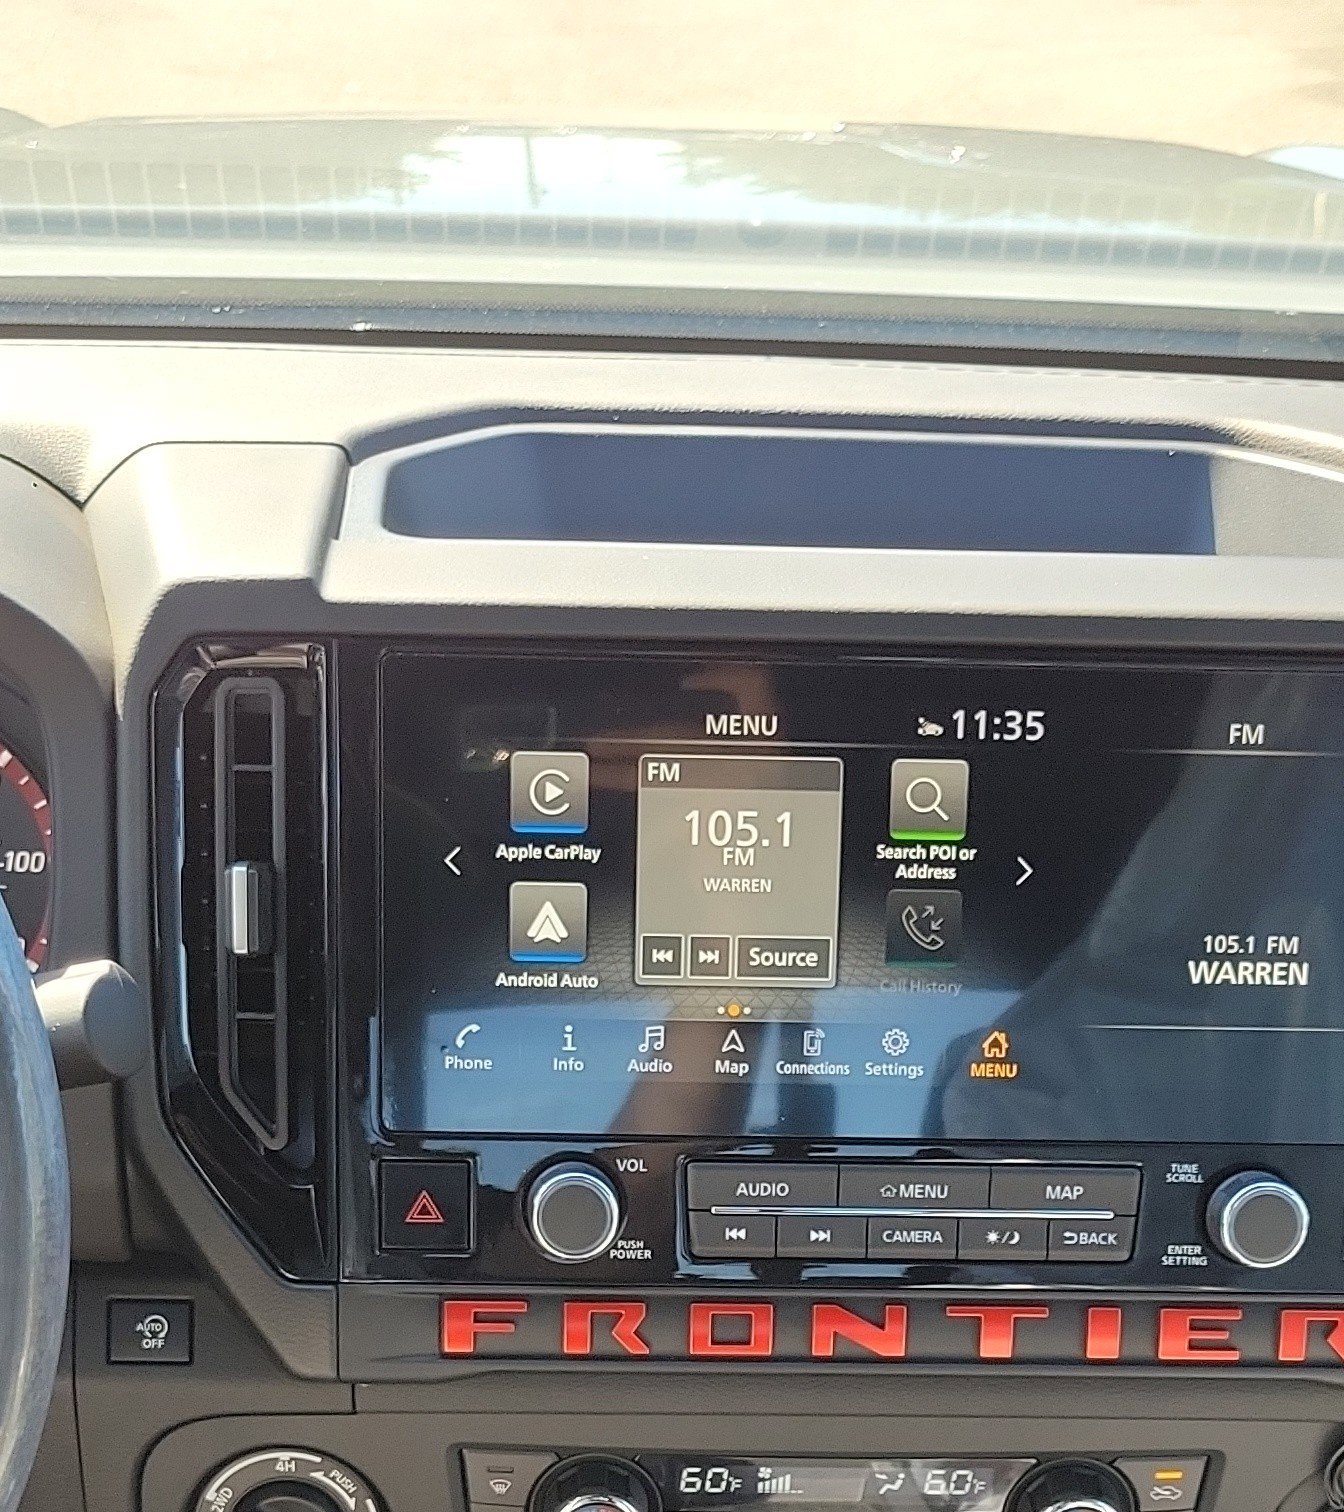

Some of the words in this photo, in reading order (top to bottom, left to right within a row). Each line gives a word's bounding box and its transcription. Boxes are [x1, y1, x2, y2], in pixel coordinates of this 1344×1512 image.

[706, 714, 777, 736] MENU
[952, 710, 1045, 741] 11:35
[1229, 723, 1265, 745] FM
[647, 762, 680, 782] FM
[685, 809, 792, 847] 105.1
[495, 843, 542, 861] Apple
[544, 843, 602, 863] CarPlay
[723, 847, 755, 866] FM
[876, 844, 927, 860] Search
[929, 845, 957, 860] POI
[959, 849, 977, 860] or
[5, 851, 46, 873] 100
[895, 865, 956, 880] Address
[703, 878, 772, 893] WARREN
[1204, 935, 1255, 954] 105.1
[1267, 936, 1299, 955] FM
[749, 947, 819, 967] Source
[495, 972, 557, 988] Android
[560, 973, 599, 988] Auto
[1188, 960, 1309, 986] WARREN
[881, 981, 907, 993] Call
[909, 981, 963, 995] History
[444, 1056, 493, 1070] Phone
[553, 1058, 584, 1071] Info
[627, 1059, 673, 1073] Audio
[715, 1060, 750, 1076] Map
[776, 1060, 850, 1076] Connections
[865, 1062, 924, 1078] Settings
[970, 1063, 1018, 1079] MENU
[616, 1158, 648, 1173] VOL
[1171, 1164, 1199, 1173] TUNE
[1165, 1173, 1205, 1183] SCROLL
[736, 1183, 789, 1197] AUDIO
[899, 1184, 948, 1199] MENU
[1046, 1185, 1084, 1200] MAP
[617, 1240, 644, 1249] PUSH
[882, 1230, 943, 1244] CAMERA
[1079, 1232, 1117, 1246] BACK
[609, 1249, 652, 1259] POWER
[1167, 1245, 1202, 1255] ENTER
[1161, 1256, 1207, 1266] SETTING
[136, 1323, 163, 1332] AUTO
[142, 1339, 165, 1349] OFF
[275, 1461, 296, 1472] 4H
[329, 1469, 357, 1494] PUSH
